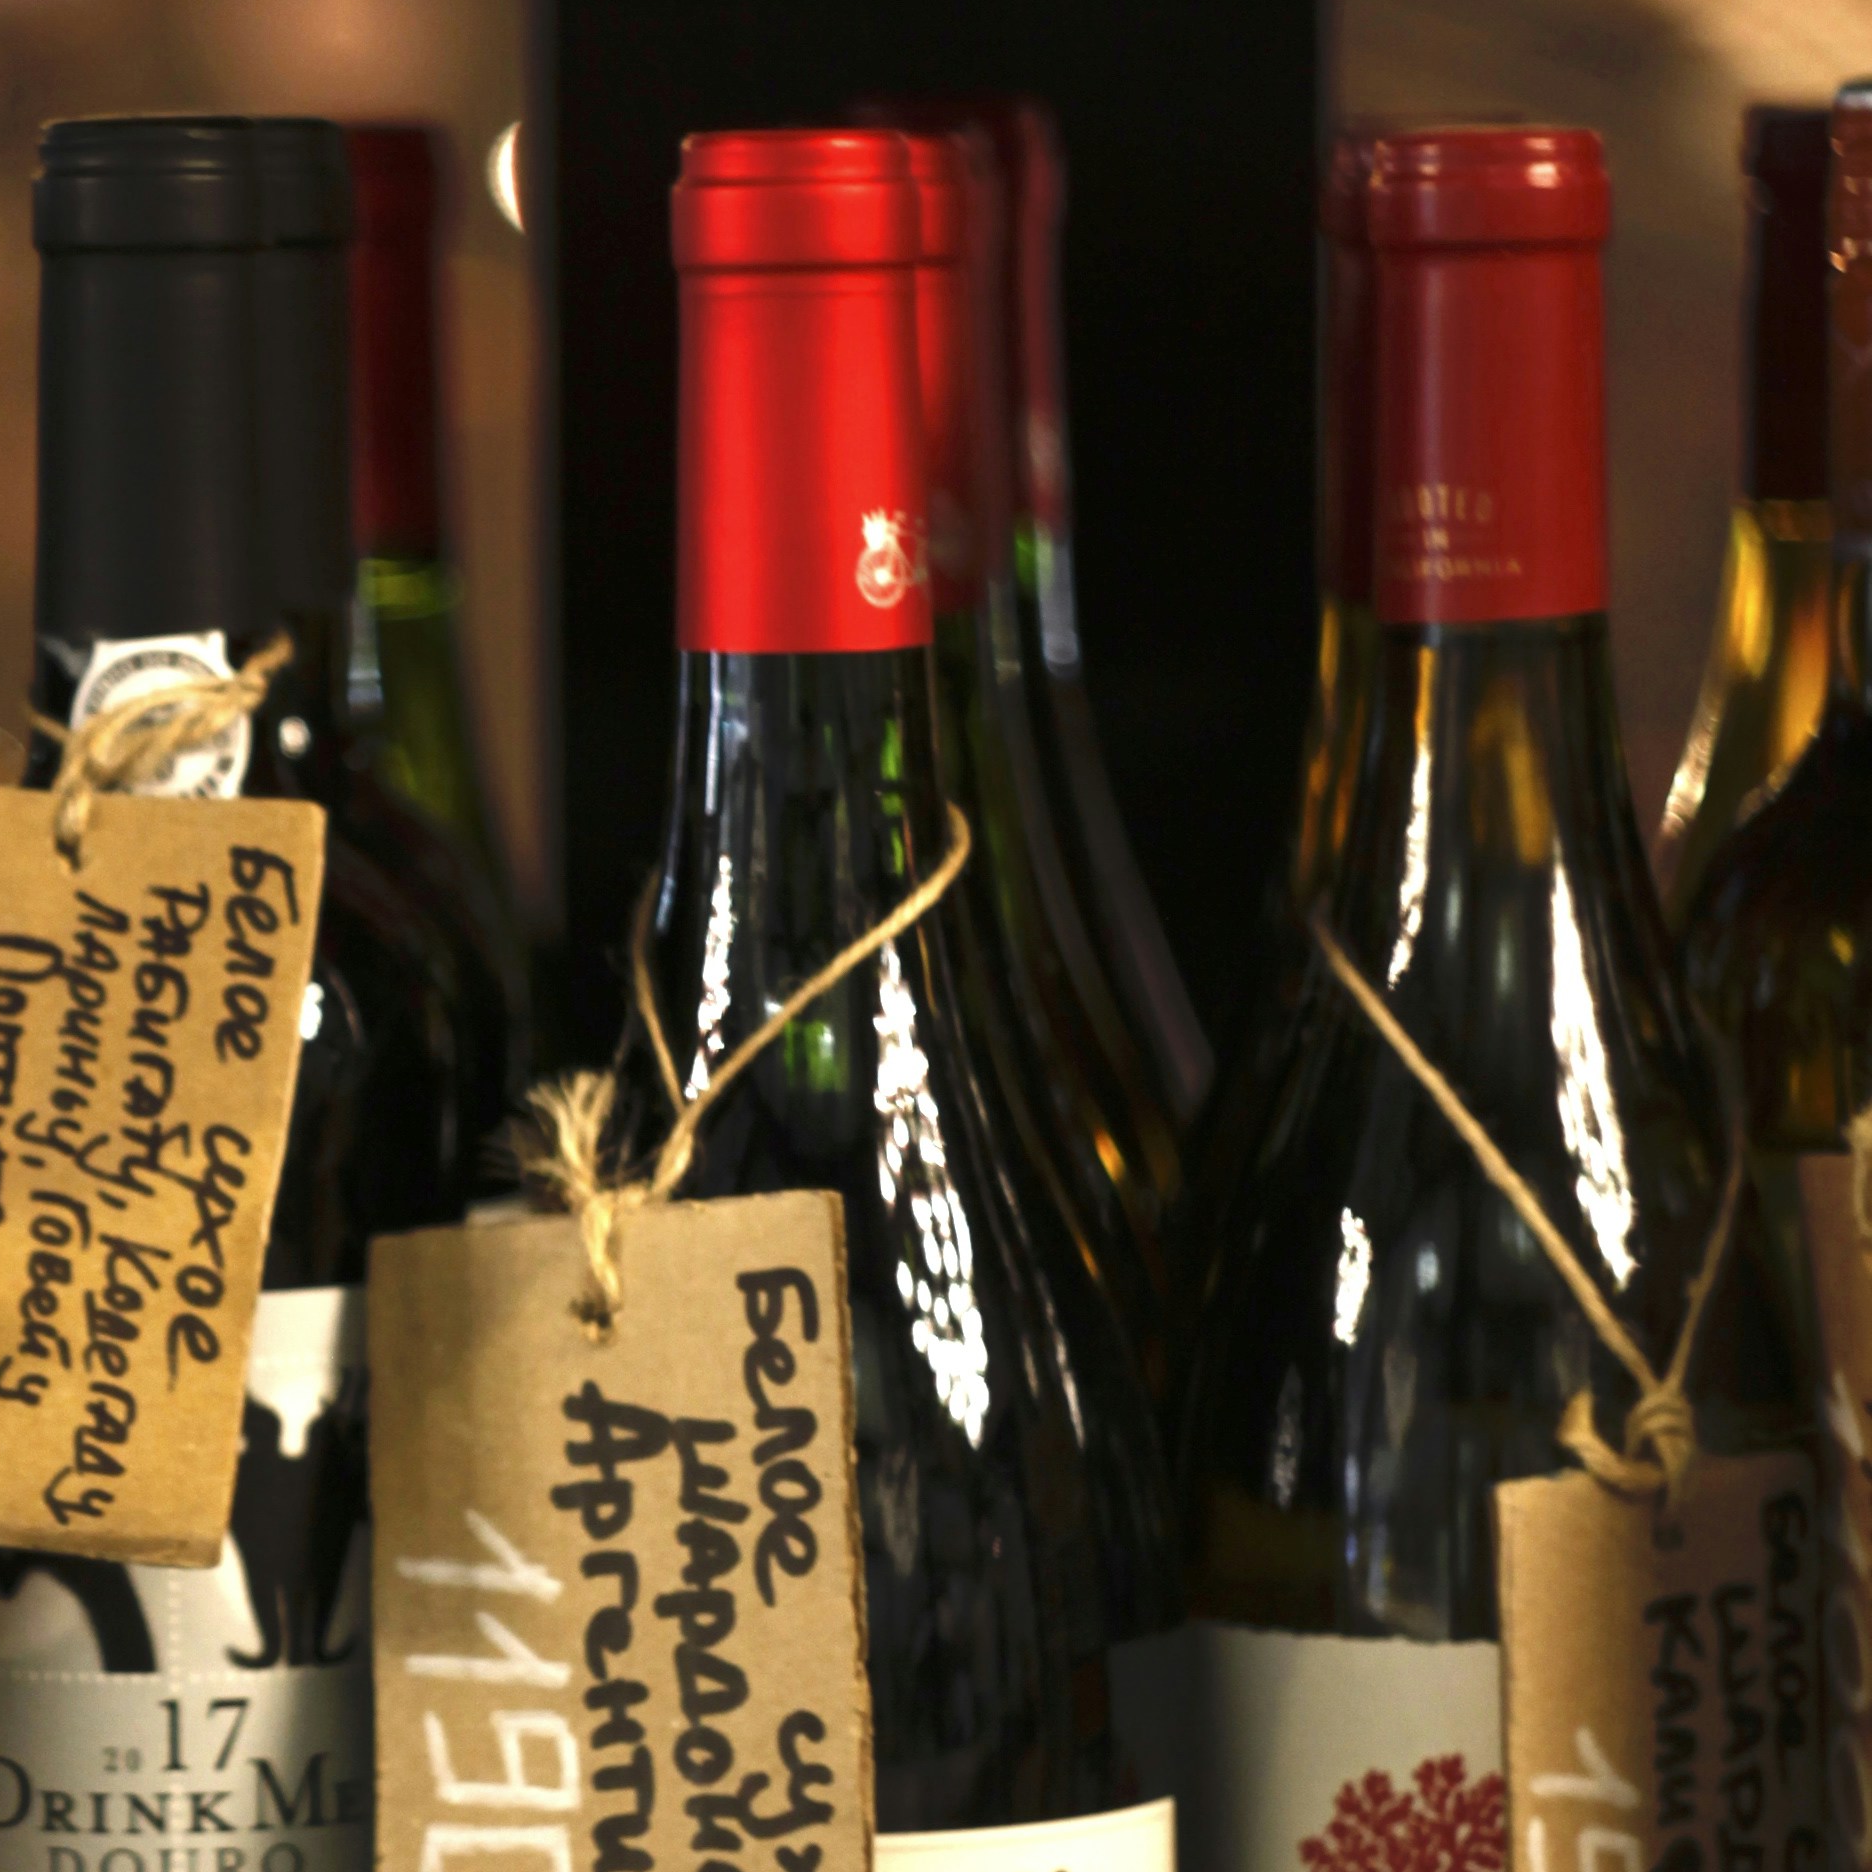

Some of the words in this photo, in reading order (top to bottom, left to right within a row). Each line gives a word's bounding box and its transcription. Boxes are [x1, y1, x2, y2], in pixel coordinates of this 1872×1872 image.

[214, 844, 300, 1066] Белое
[166, 1123, 254, 1396] сухое
[736, 1267, 824, 1608] Белое
